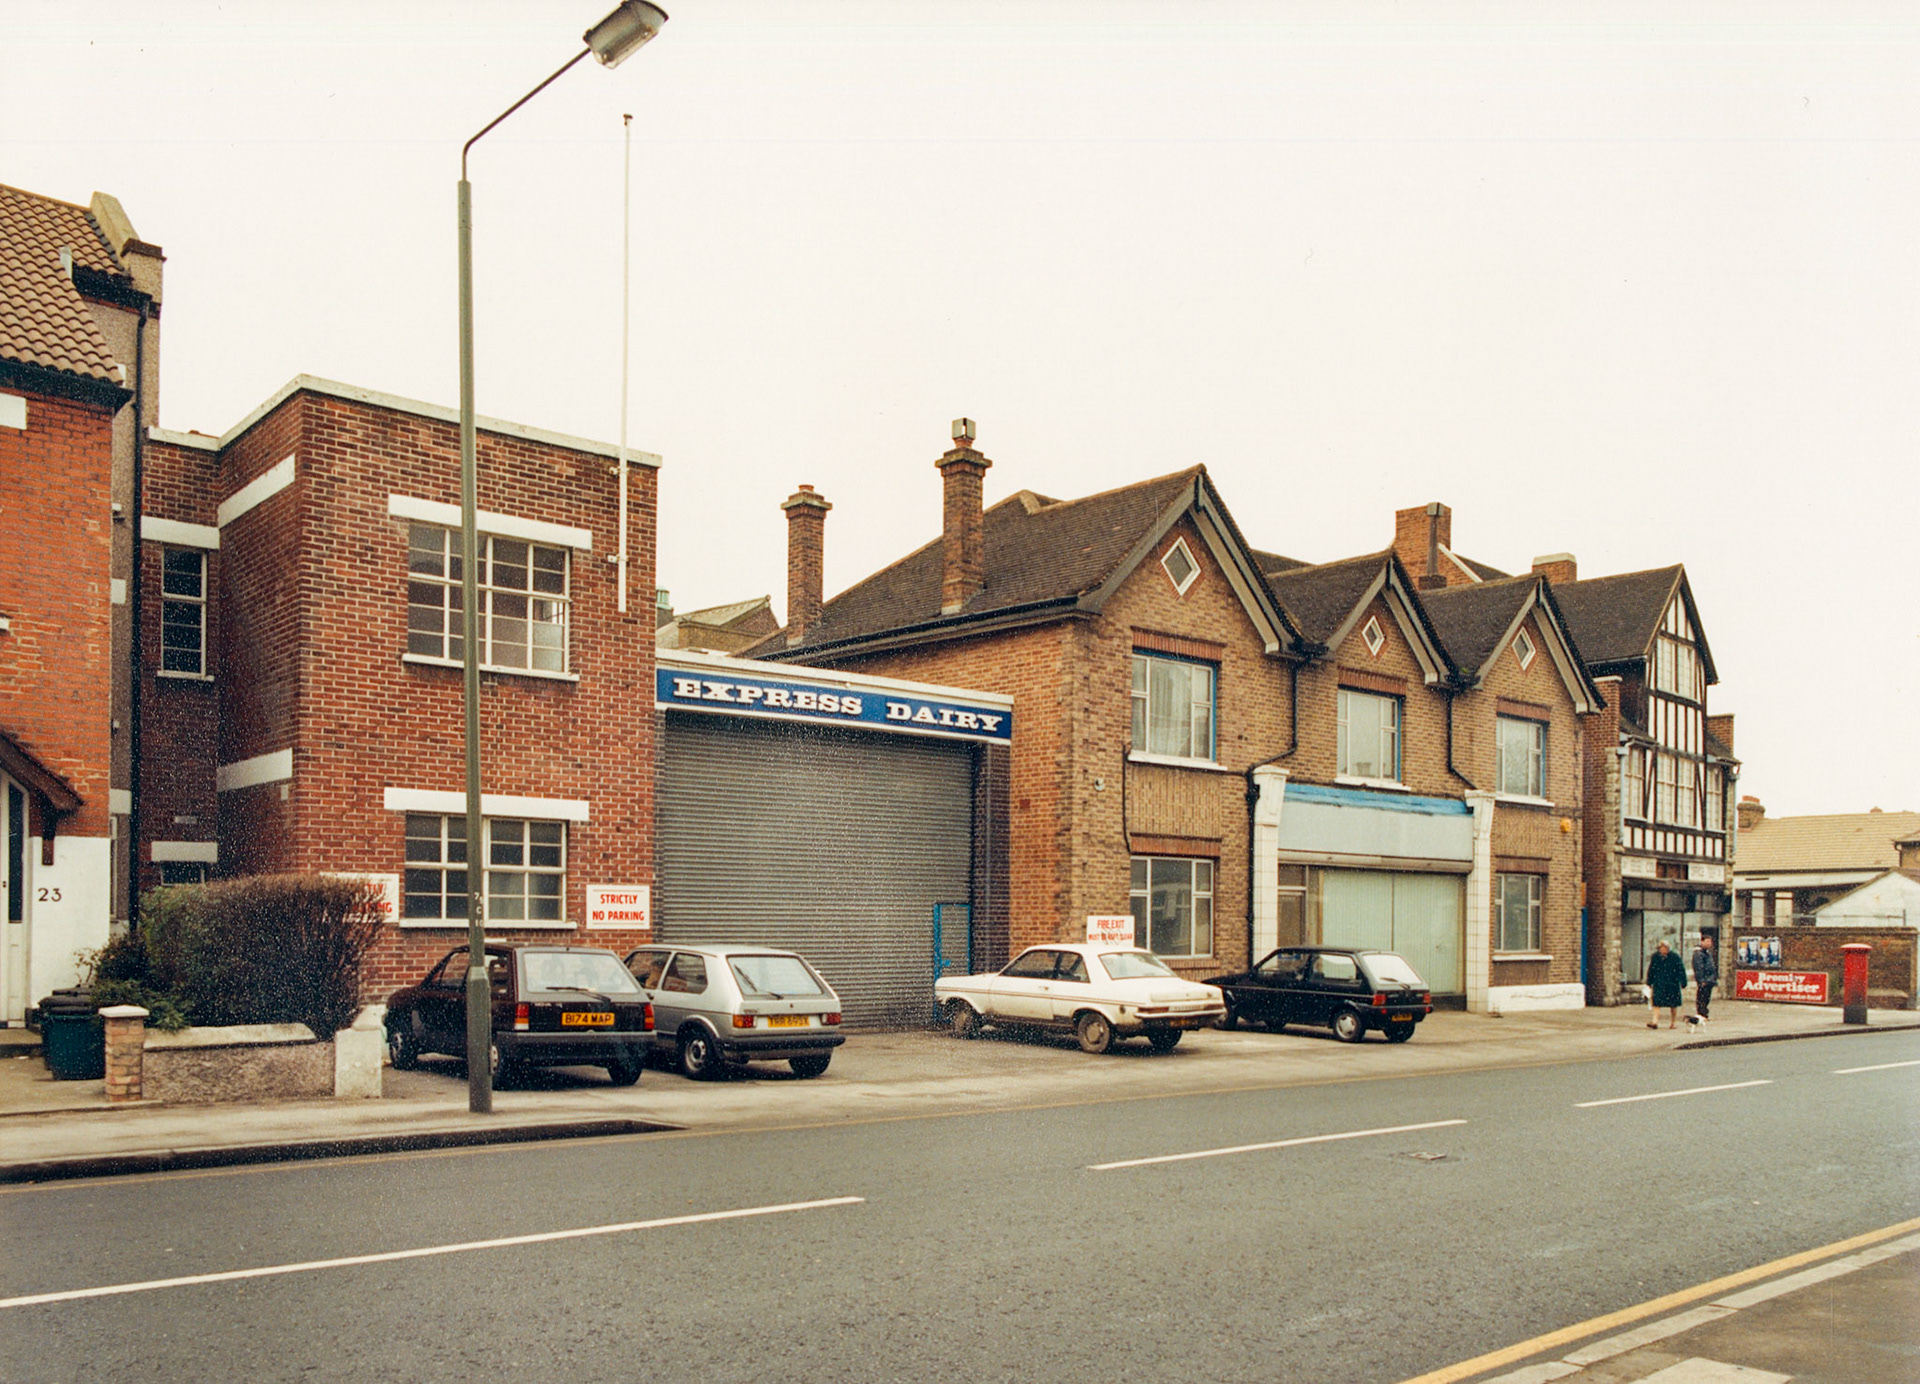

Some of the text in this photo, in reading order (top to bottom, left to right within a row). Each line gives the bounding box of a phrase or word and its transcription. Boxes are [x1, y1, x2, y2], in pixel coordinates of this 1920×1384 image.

[672, 677, 1003, 732] EXPRESS DAIRY
[38, 887, 62, 902] 23
[600, 894, 638, 905] STRICTLY
[592, 910, 645, 921] NO PARKING
[1097, 919, 1124, 929] FIRE EXIT
[1742, 979, 1819, 993] Advertiser
[565, 1013, 612, 1024] B174 MAP
